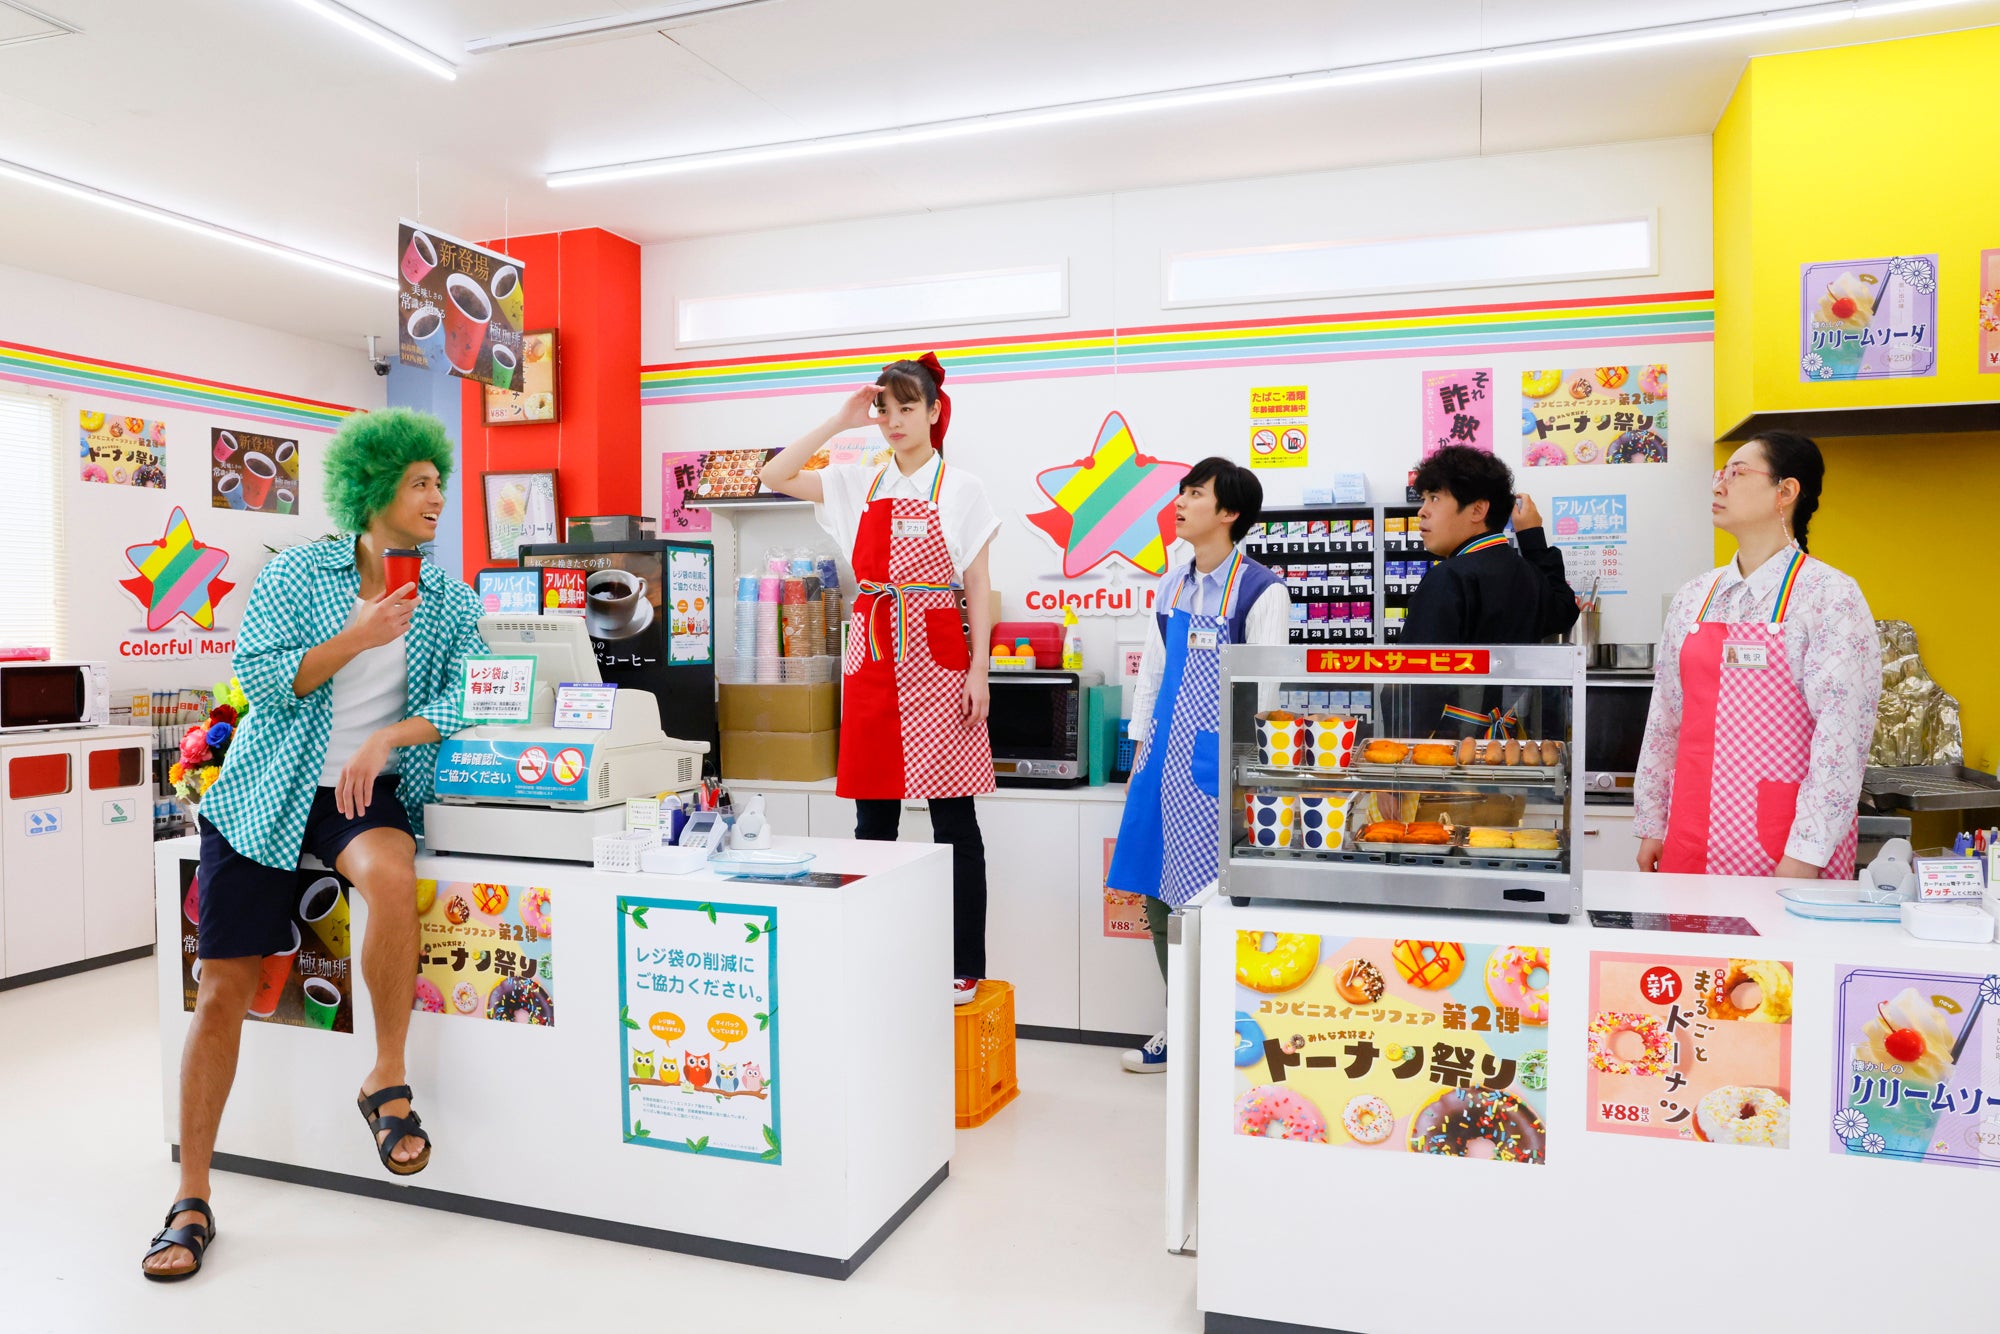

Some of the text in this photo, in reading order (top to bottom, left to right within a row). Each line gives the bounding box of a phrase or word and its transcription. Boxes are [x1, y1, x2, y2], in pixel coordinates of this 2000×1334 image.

[440, 241, 489, 282] 新登場
[411, 283, 443, 300] 美味しさの
[490, 320, 521, 347] 極珈琲
[1813, 324, 1926, 349] クリームソーダ
[1471, 372, 1489, 401] それ
[1252, 391, 1306, 402] たばこ・酒類
[1533, 391, 1655, 409] コンビニスイーツフェア 第2弾
[1253, 404, 1306, 413] 年齢確認実施中
[1440, 384, 1480, 443] 詐欺
[1536, 411, 1654, 440] ドーナツ祭り
[1556, 498, 1623, 515] アルバイト
[673, 508, 688, 527] かも
[1579, 514, 1624, 530] 募集中
[495, 522, 554, 537] クリームソーダ
[482, 576, 536, 592] アルバイト
[545, 573, 585, 590] アルバイト
[500, 592, 536, 608] 募集中
[558, 588, 585, 605] 募集中
[1026, 588, 1131, 610] Colorful
[119, 640, 193, 656] Colorful
[1320, 651, 1476, 671] ホットサービス
[471, 667, 509, 680] レジ袋は
[471, 681, 506, 694] 有料です
[451, 752, 502, 766] 年齢確認に
[438, 769, 511, 785] ご協力ください
[1925, 888, 1983, 896] タッチしてください
[499, 923, 537, 943] 第2弾
[1111, 921, 1129, 930] ¥88
[298, 950, 347, 979] 極珈琲
[636, 947, 755, 973] レジ袋の削減に
[636, 972, 762, 1003] ご協力ください。
[1647, 973, 1675, 998] 新
[1939, 998, 1954, 1010] new
[1259, 1000, 1520, 1034] コンビニスイーツフェア 第2弾
[1694, 970, 1716, 1063] まるごと
[1262, 1038, 1517, 1090] ドーナツ祭り
[1660, 1005, 1694, 1123] ドーナツ
[1852, 1060, 1904, 1075] 懐かしの
[1853, 1074, 2000, 1115] クリームソー
[1601, 1104, 1650, 1123] ¥88 税込
